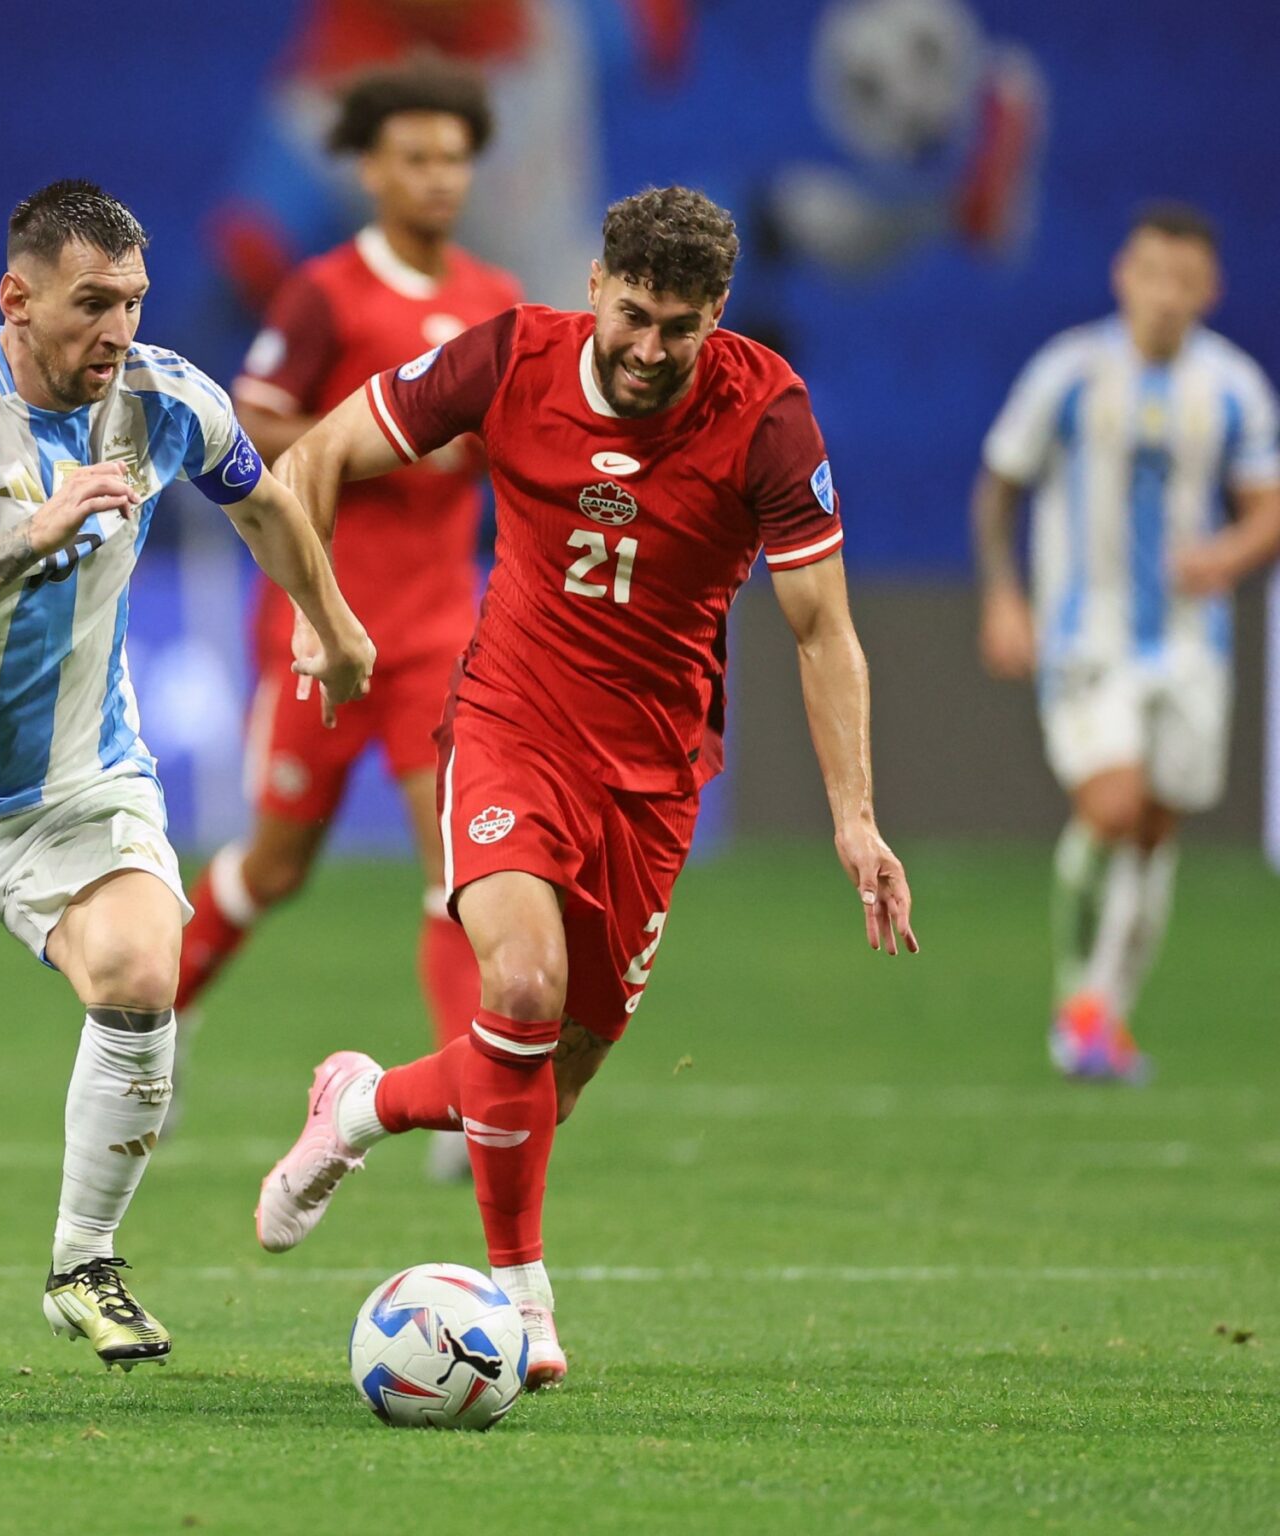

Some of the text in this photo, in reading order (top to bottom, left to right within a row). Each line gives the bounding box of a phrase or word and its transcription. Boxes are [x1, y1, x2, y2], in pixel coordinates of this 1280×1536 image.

[581, 498, 635, 514] CANADA
[564, 529, 639, 604] 21
[470, 818, 511, 832] CANADA
